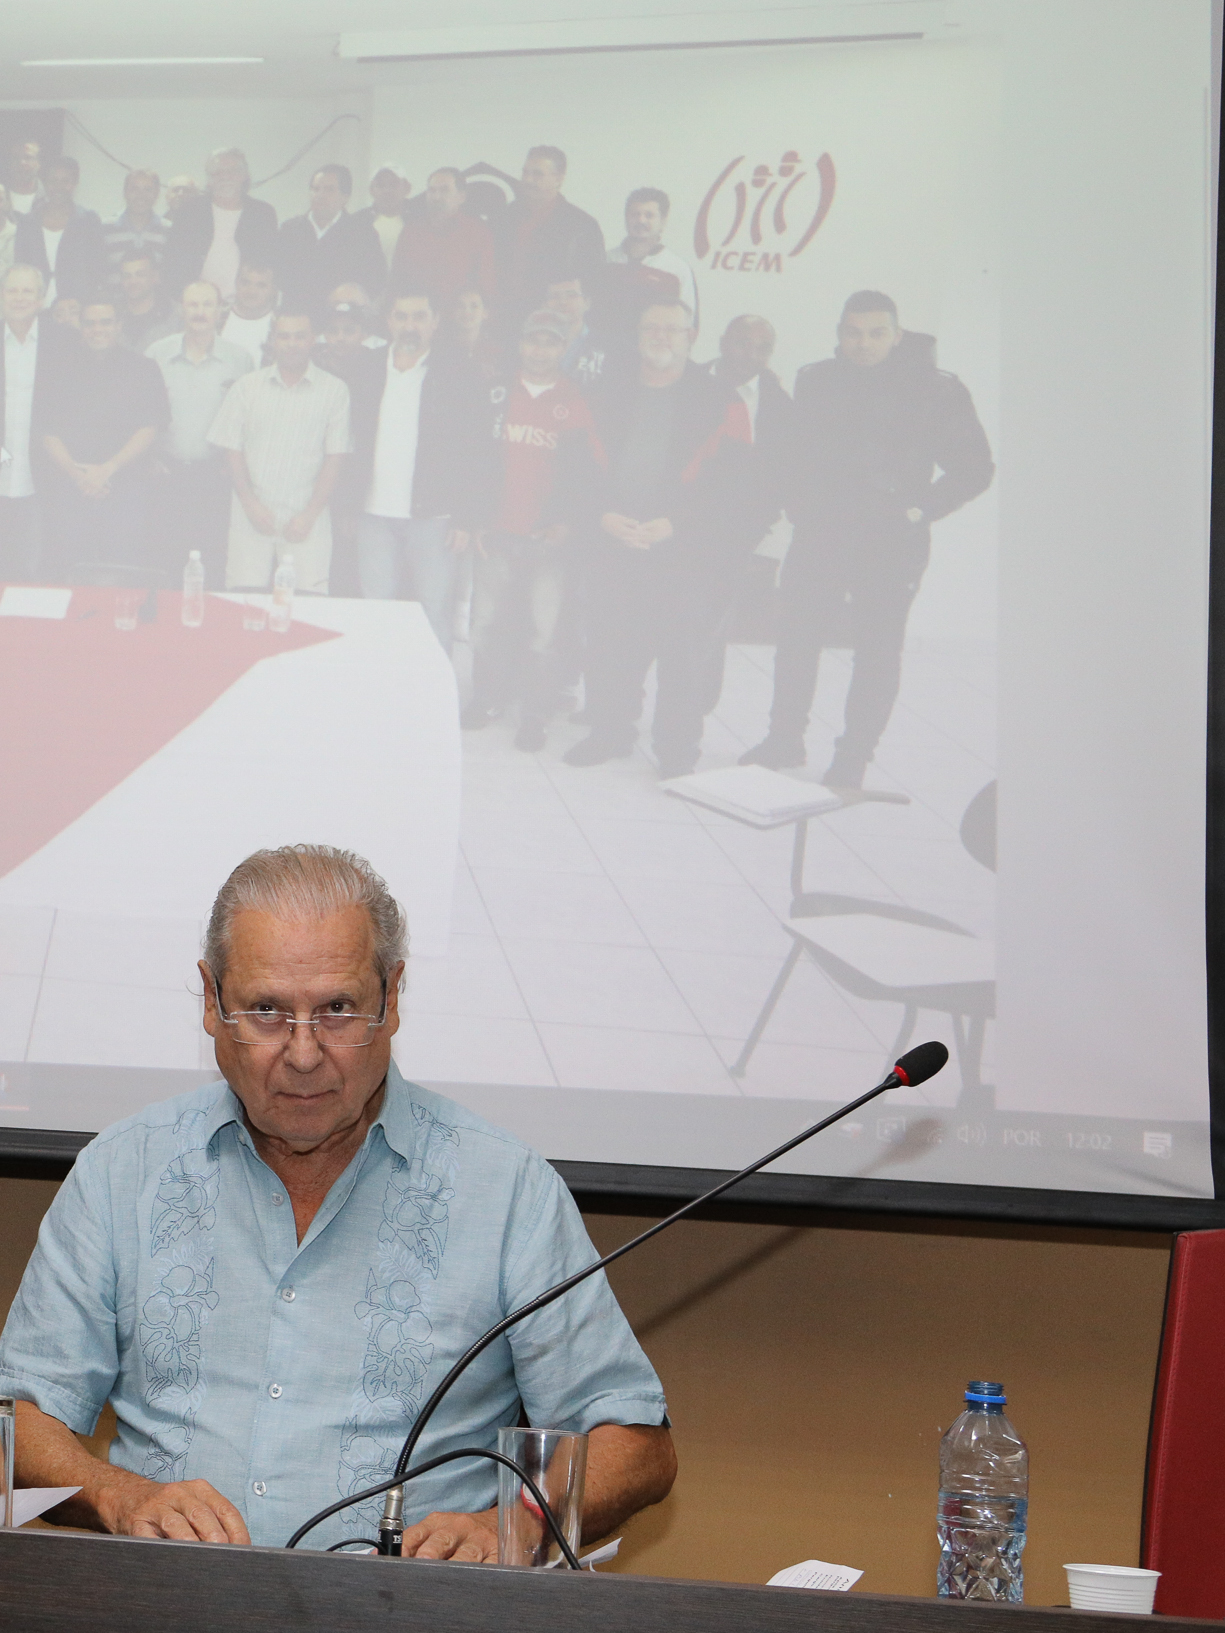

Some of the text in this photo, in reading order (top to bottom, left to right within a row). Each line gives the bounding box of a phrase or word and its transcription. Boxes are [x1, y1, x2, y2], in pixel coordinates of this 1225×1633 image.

[710, 250, 783, 274] ICEM
[503, 423, 559, 450] WISS
[1002, 1127, 1042, 1148] POR
[1066, 1131, 1113, 1151] 12:02
